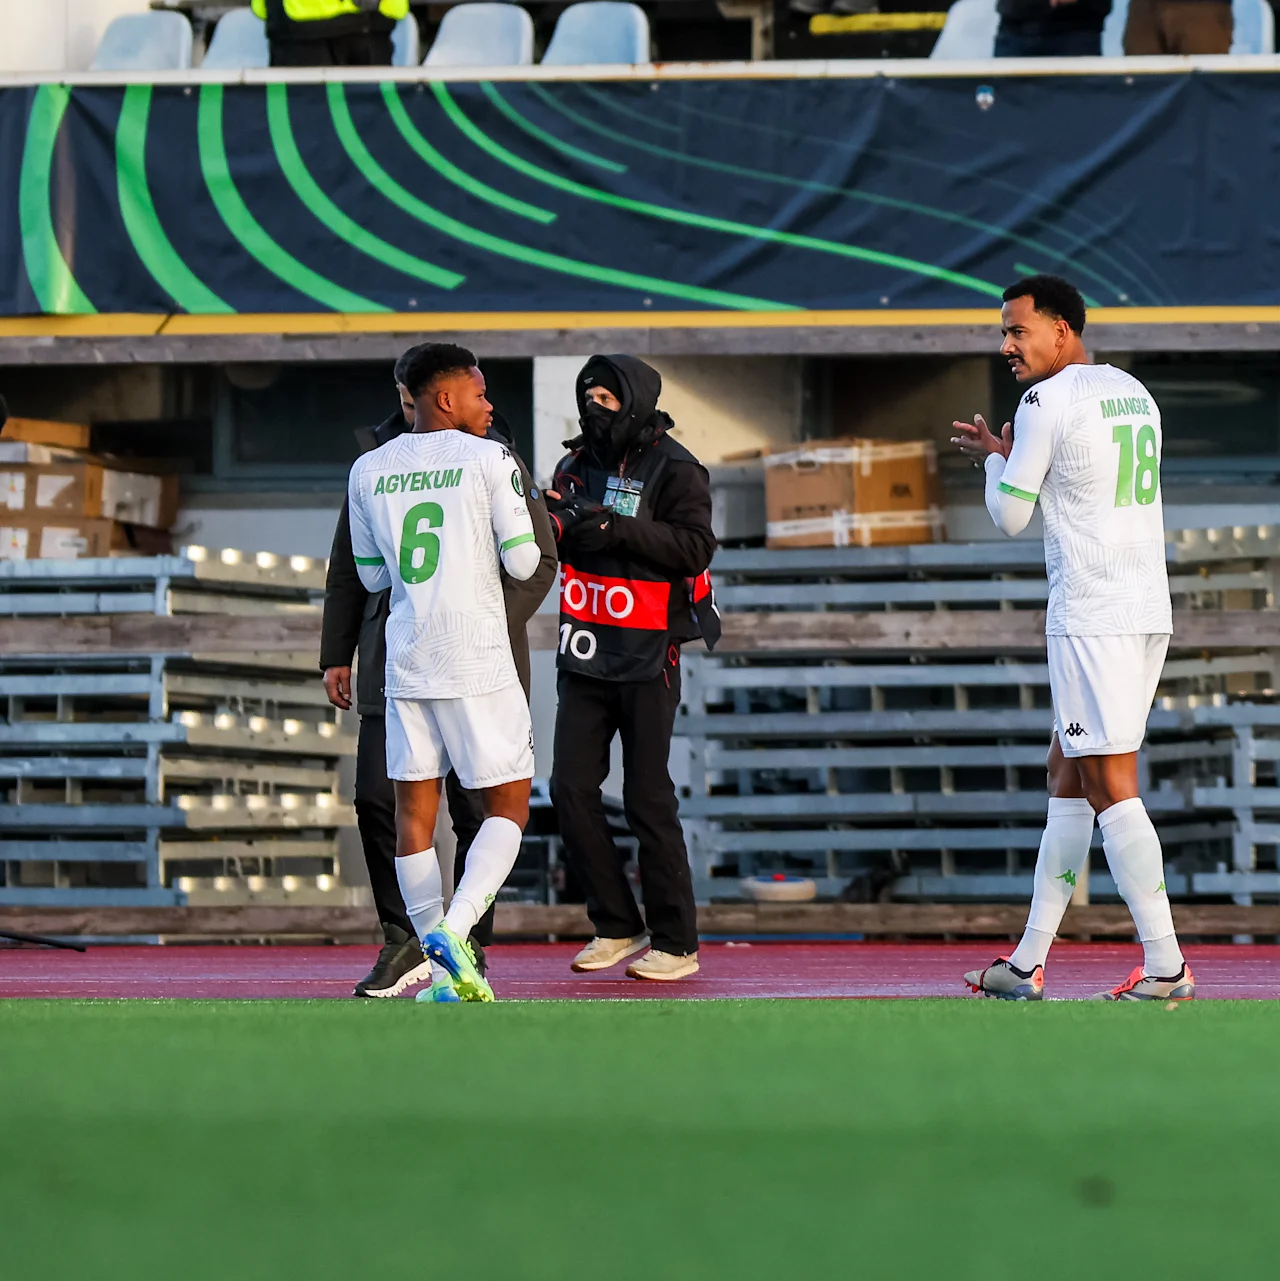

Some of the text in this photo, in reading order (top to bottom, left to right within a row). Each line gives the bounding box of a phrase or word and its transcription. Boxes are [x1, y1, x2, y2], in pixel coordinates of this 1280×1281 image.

[1100, 397, 1151, 419] MIANGUE
[374, 468, 463, 496] AGYEKUM
[1112, 424, 1159, 508] 18
[399, 501, 444, 585] 6
[560, 622, 597, 660] 10
